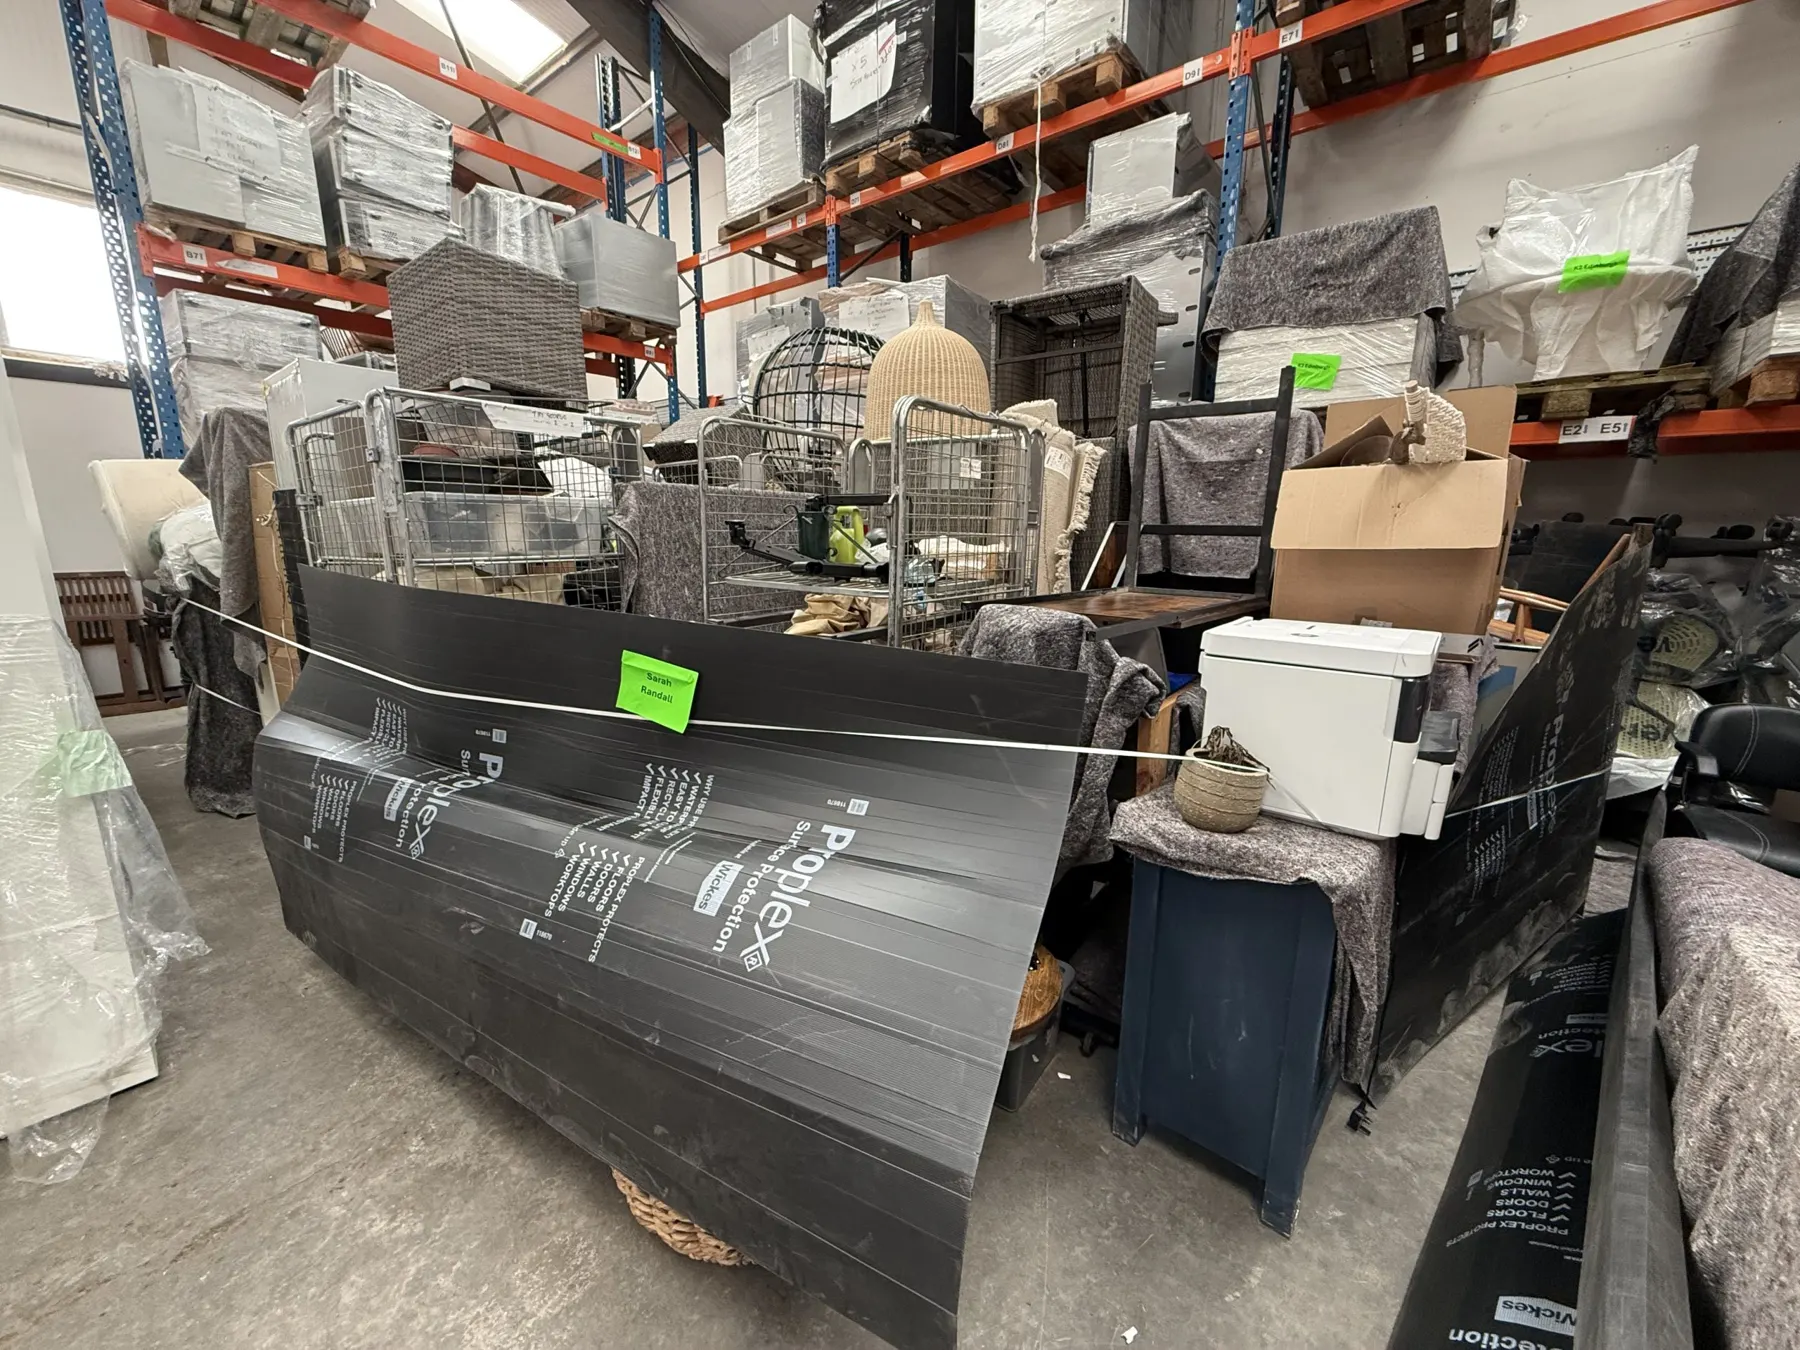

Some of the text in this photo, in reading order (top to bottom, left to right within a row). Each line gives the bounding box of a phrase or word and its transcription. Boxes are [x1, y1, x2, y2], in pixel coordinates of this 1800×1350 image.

[641, 685, 673, 703] Randall
[646, 672, 672, 687] Sarah
[371, 707, 380, 736] IMPACT
[324, 788, 334, 818] WALLS
[636, 775, 652, 811] IMPACT
[674, 782, 688, 809] EASY
[703, 775, 714, 796] WHY
[312, 784, 323, 833] WORKTOPS
[317, 786, 328, 829] WINDOWS
[330, 789, 340, 820] DOORS
[335, 790, 347, 827] FLOORS
[338, 780, 357, 863] PROPLEX PROTECTS
[666, 810, 679, 822] TO
[695, 797, 708, 815] USE
[545, 854, 580, 917] WORKTOPS
[558, 857, 591, 912] WINDOWS
[577, 861, 602, 899] WALLS
[587, 863, 613, 903] DOORS
[595, 866, 624, 913] FLOORS
[698, 863, 733, 911] Wickes
[739, 824, 856, 966] Proplex
[588, 857, 645, 963] PROPLEX PROTECTS
[712, 863, 774, 953] Protection
[1496, 1198, 1549, 1208] DOORS
[1500, 1188, 1551, 1197] WALLS
[1486, 1209, 1547, 1220] FLOORS
[1446, 1221, 1568, 1248] PROPLEX PROTECTS
